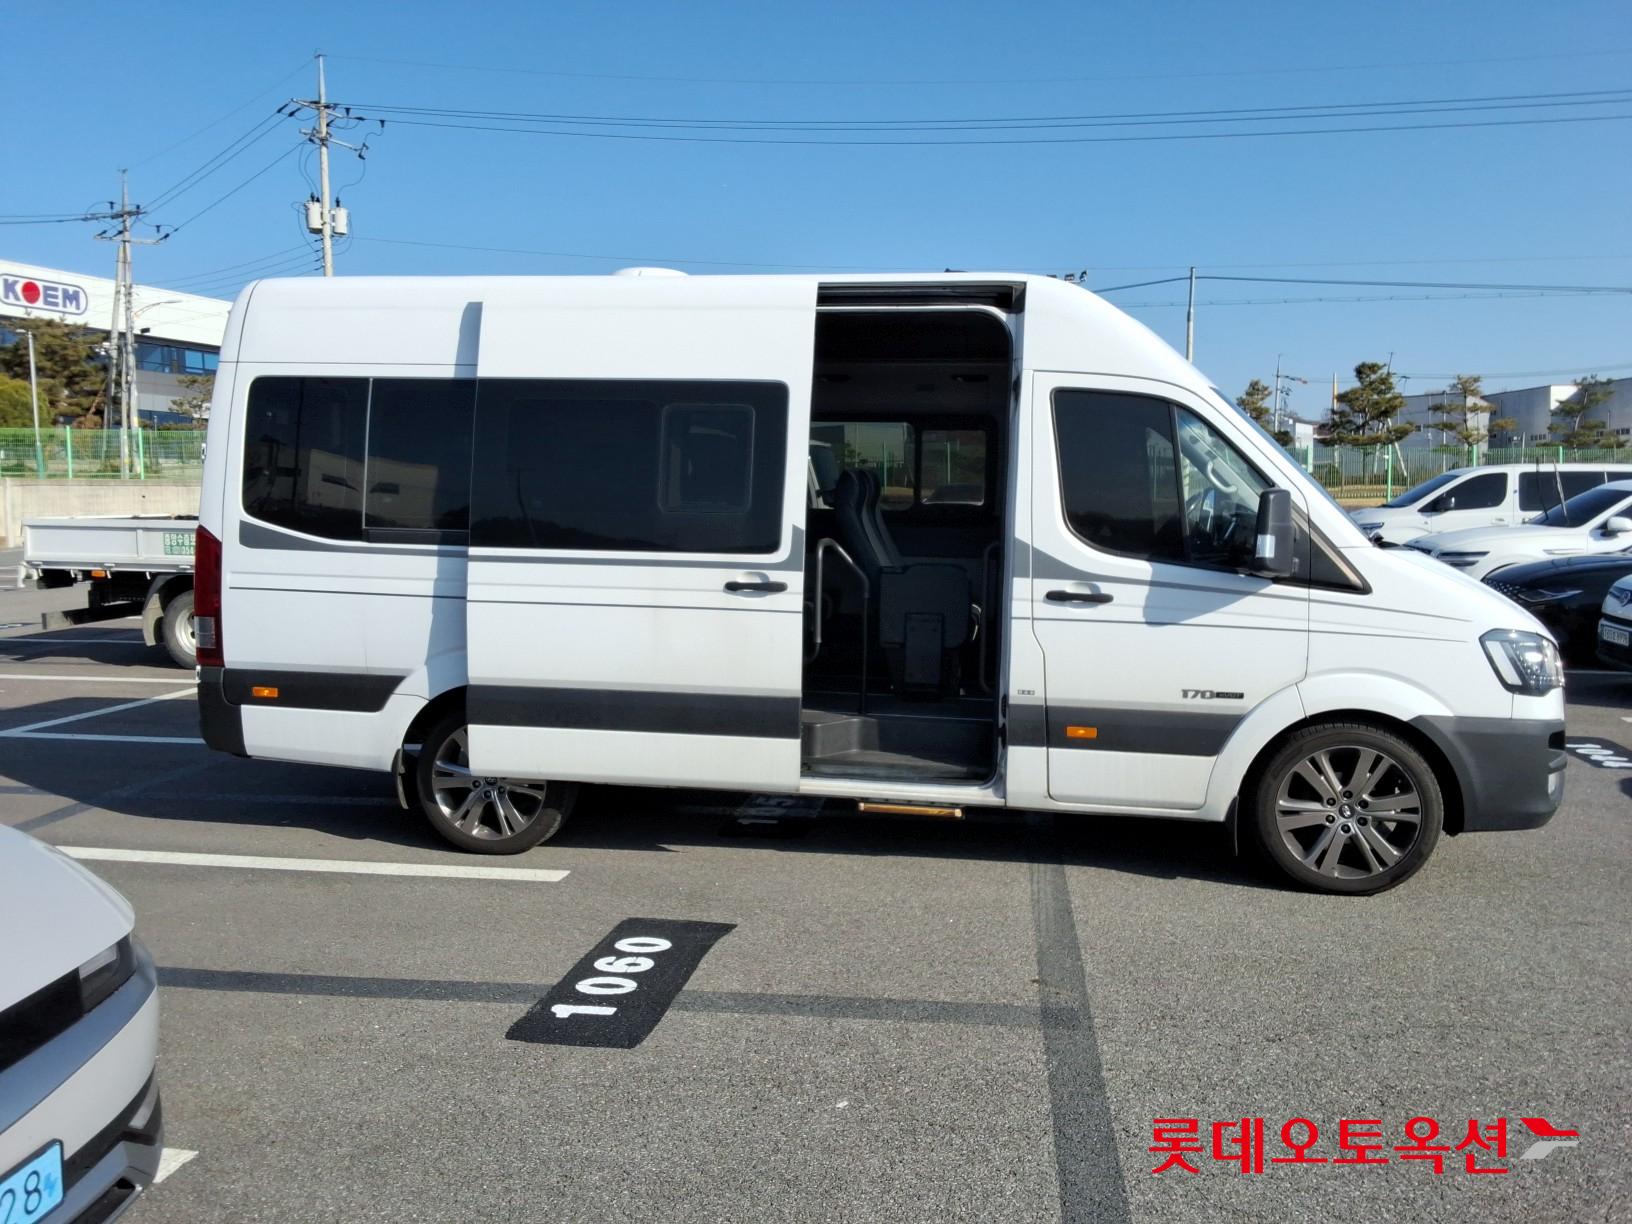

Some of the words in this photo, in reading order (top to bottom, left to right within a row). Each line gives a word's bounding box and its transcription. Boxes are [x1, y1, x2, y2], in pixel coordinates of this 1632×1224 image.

[3, 278, 80, 310] KOEM
[1182, 689, 1216, 699] 170
[550, 936, 673, 1019] 1060
